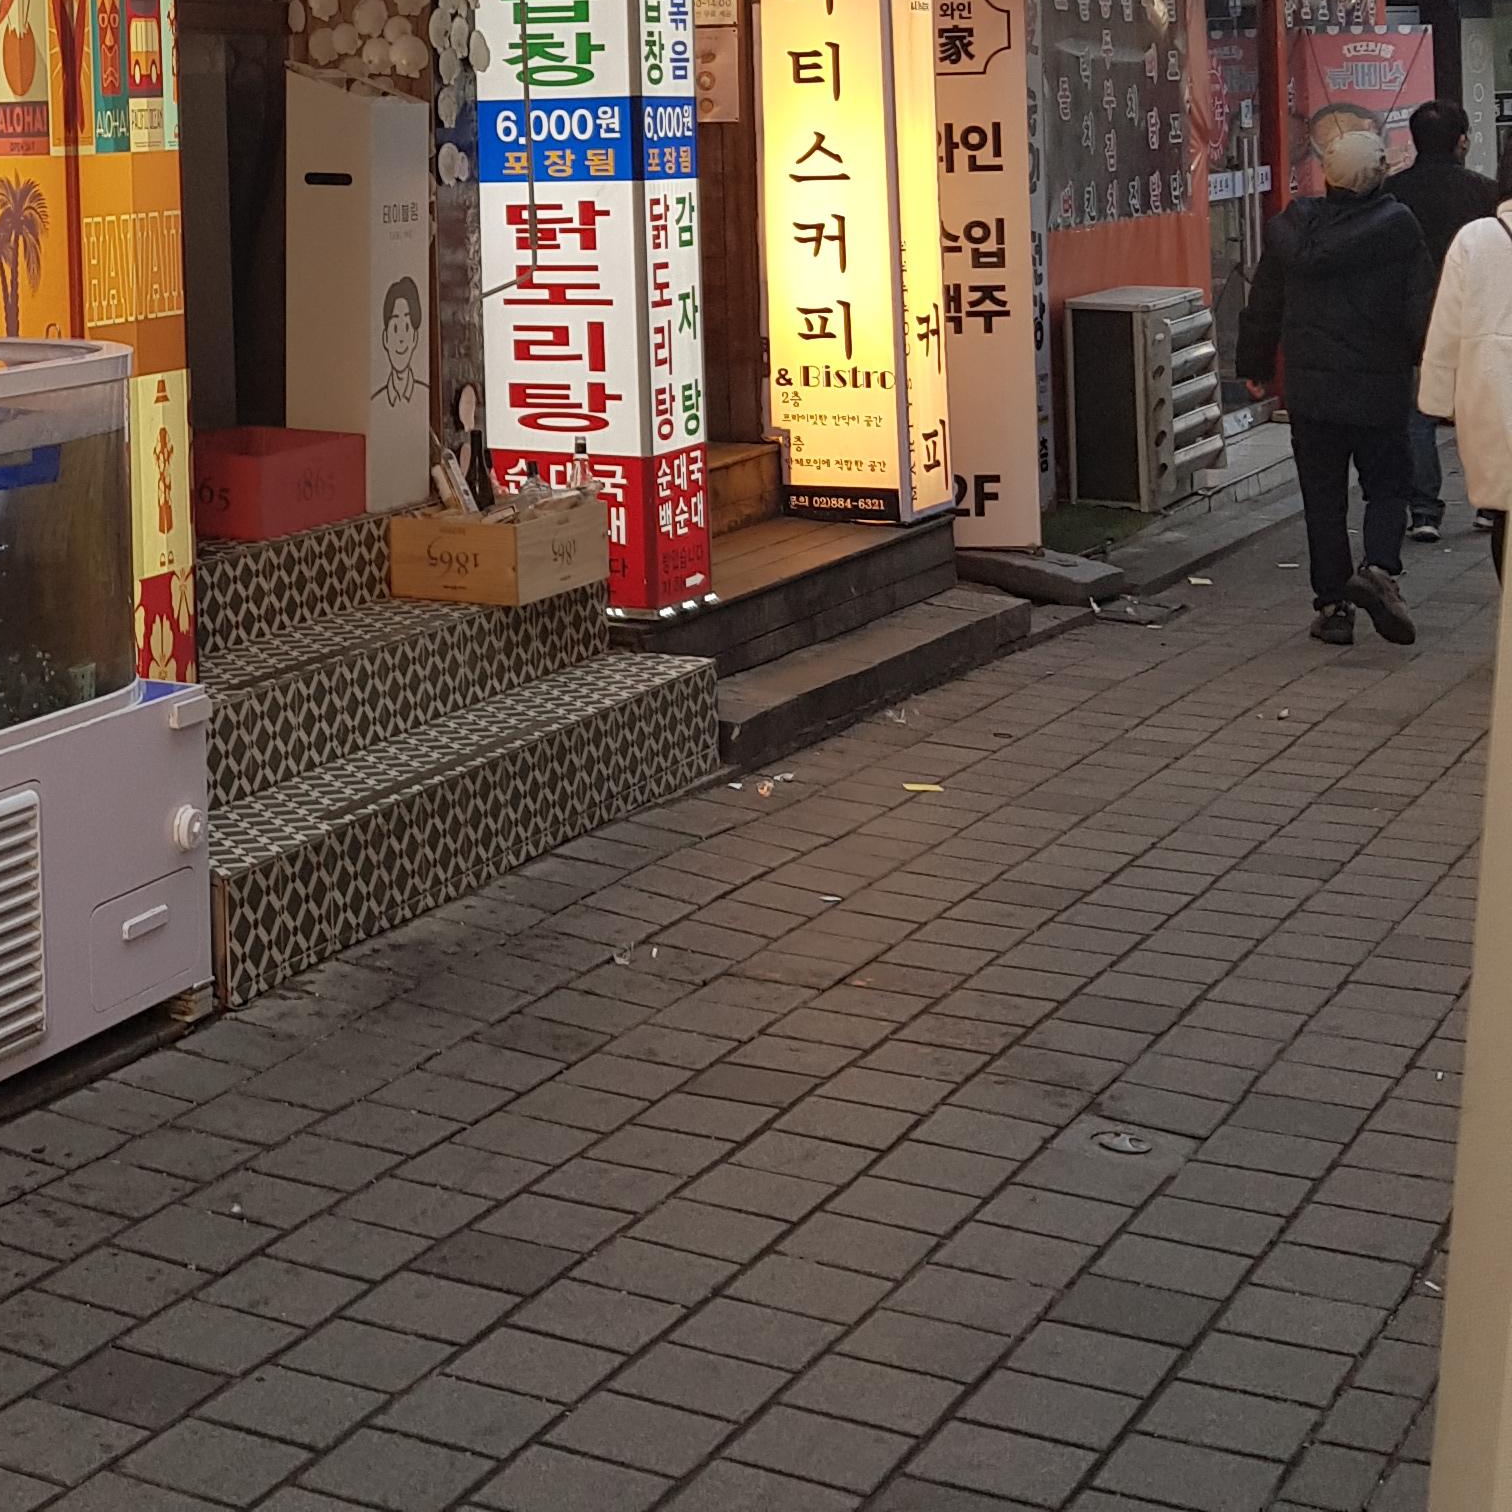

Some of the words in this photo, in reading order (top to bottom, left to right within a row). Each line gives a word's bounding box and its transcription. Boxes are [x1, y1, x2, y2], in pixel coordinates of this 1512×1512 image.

[939, 1, 973, 20] 와인
[938, 25, 975, 65] 家
[495, 105, 622, 145] 6,000원
[644, 104, 694, 140] 6,000원
[503, 148, 616, 177] 포장됨
[647, 145, 693, 173] 포장됨
[83, 210, 185, 326] HAWAII
[503, 200, 624, 433] 닭도리탕
[649, 194, 675, 442] 닭도리탕
[674, 191, 702, 437] 감자탕
[775, 368, 794, 386] &
[800, 365, 896, 389] Bistro
[781, 391, 802, 407] 2층
[656, 449, 704, 499] 순대국
[658, 490, 705, 539] 백순대
[812, 496, 885, 510] 02)884-6321
[953, 474, 1001, 517] 2F
[426, 535, 480, 578] 1865
